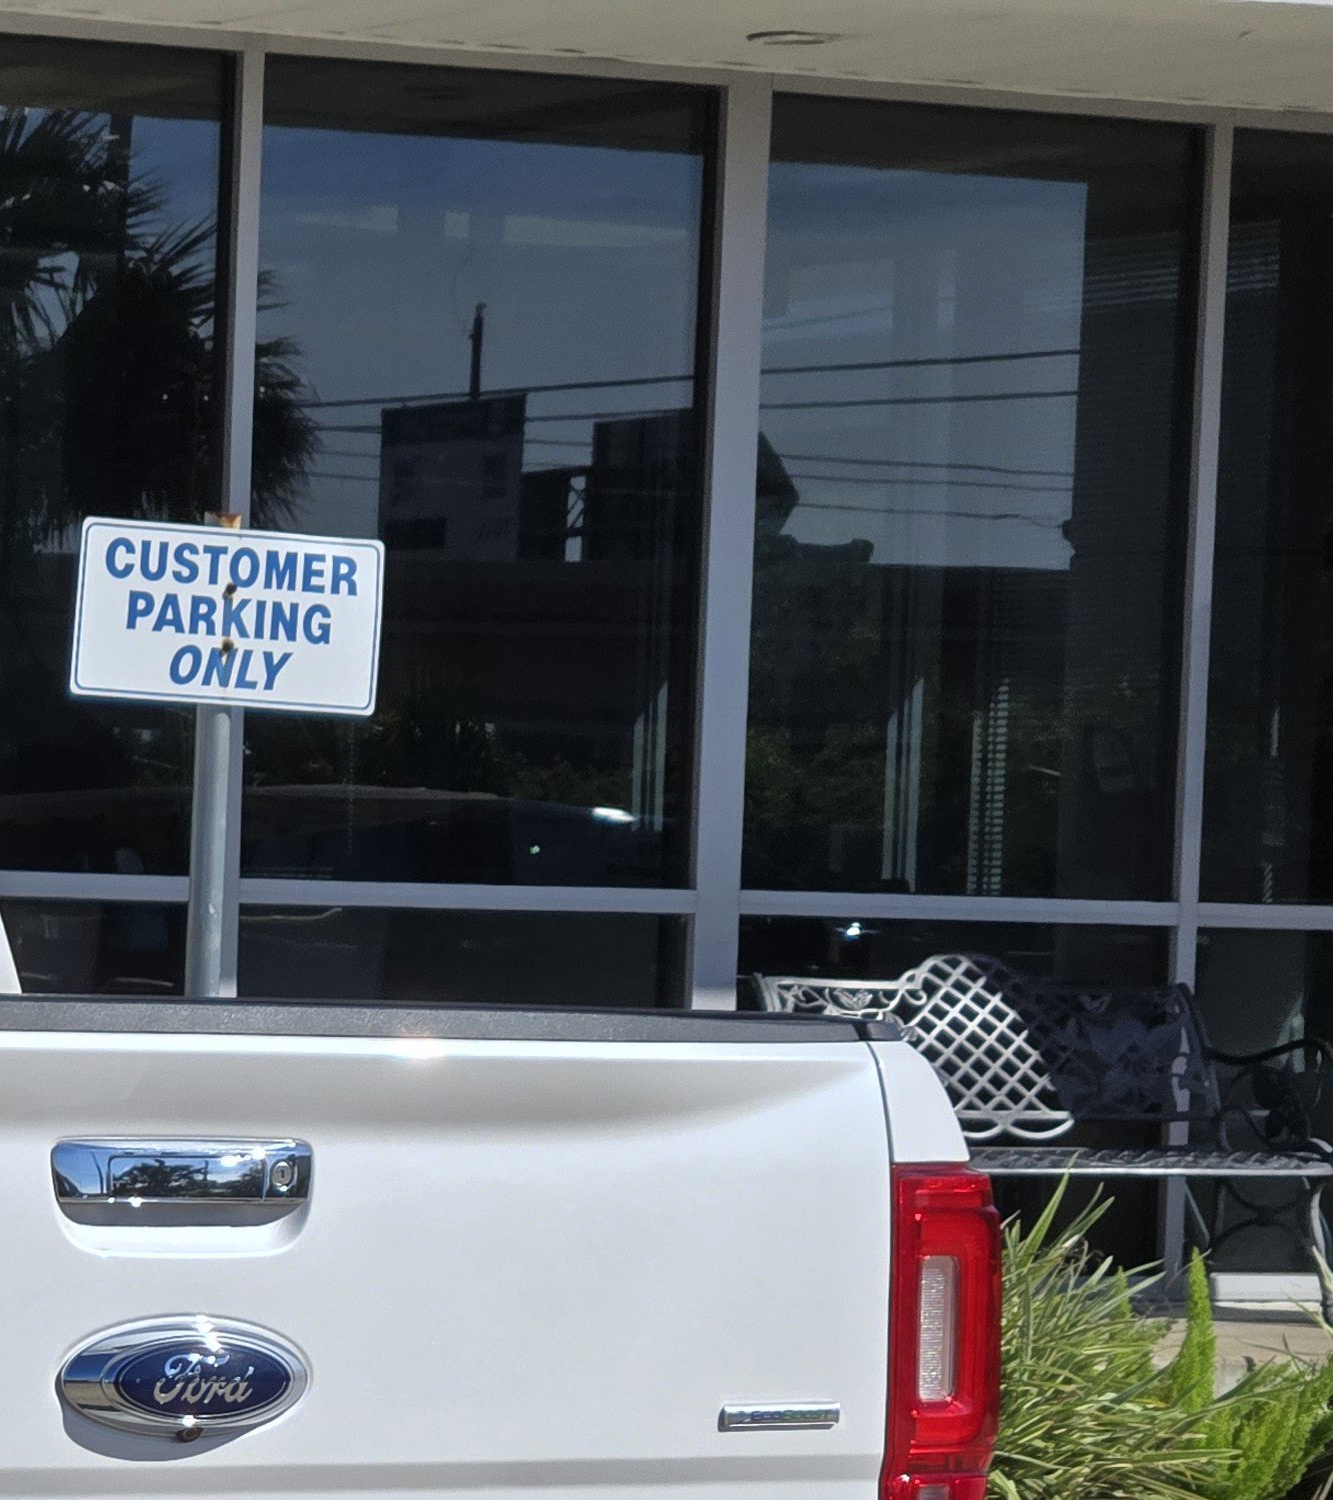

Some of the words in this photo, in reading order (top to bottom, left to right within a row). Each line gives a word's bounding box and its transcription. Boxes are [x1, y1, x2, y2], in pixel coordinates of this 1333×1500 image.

[105, 537, 357, 596] CUSTOMER
[126, 590, 332, 645] PARKING
[169, 645, 293, 691] ONLY
[153, 1354, 255, 1405] Ford
